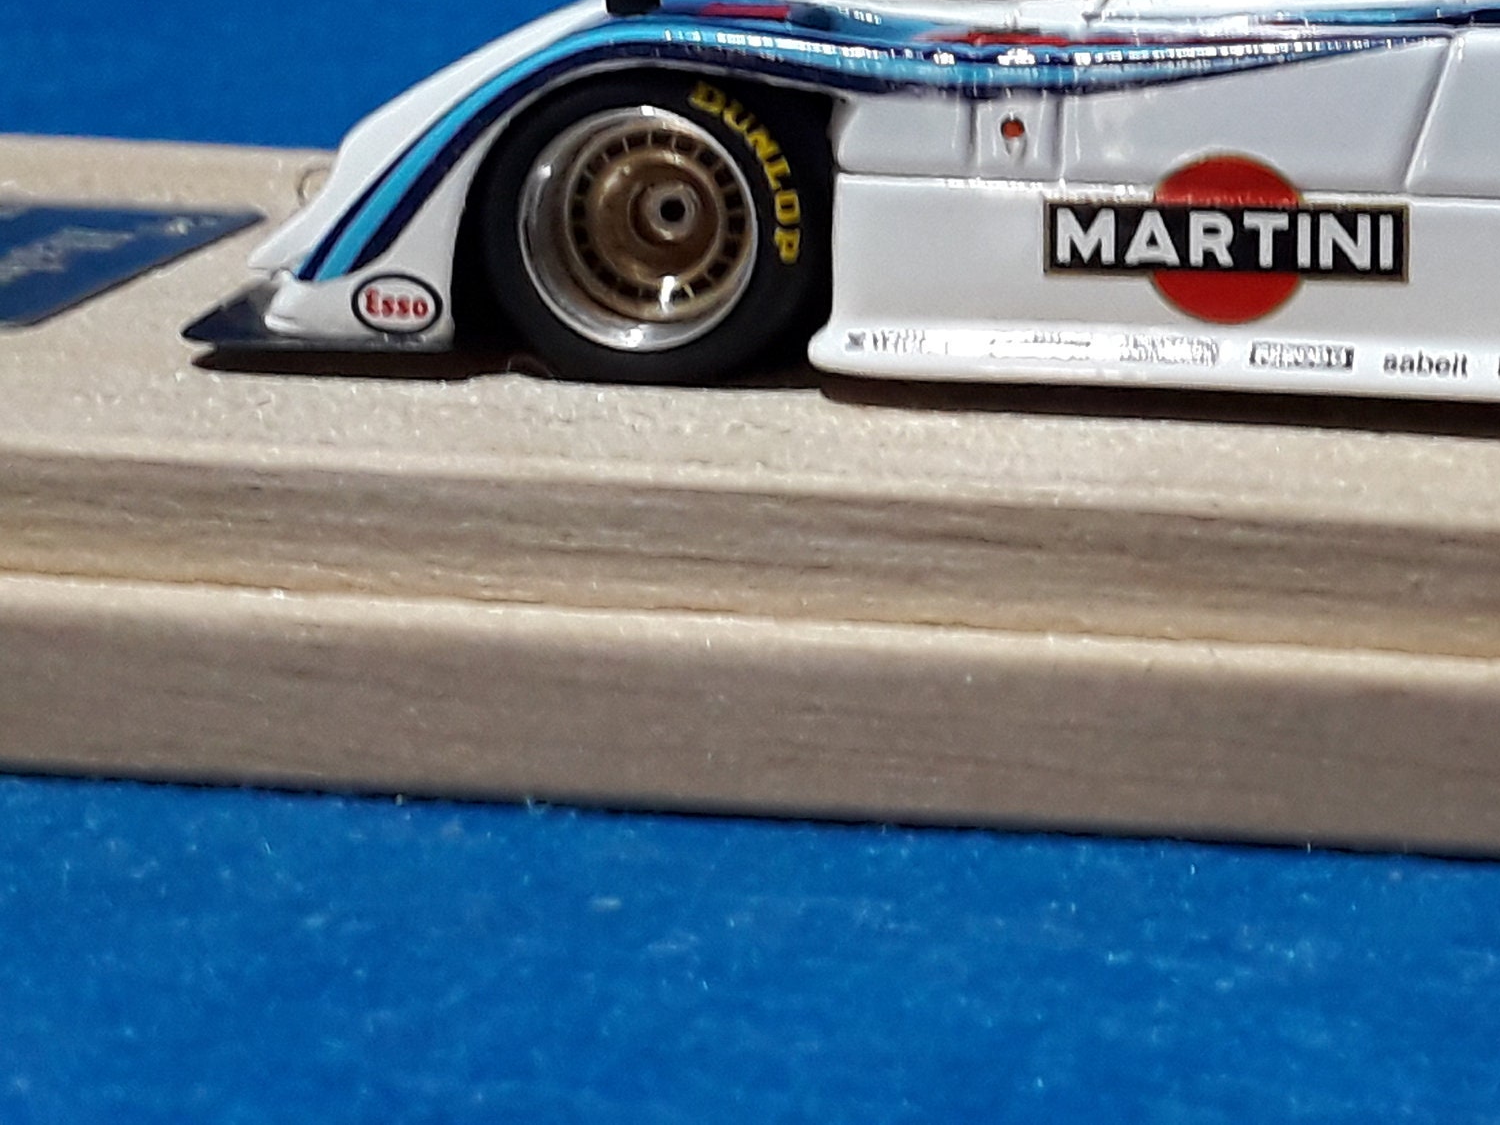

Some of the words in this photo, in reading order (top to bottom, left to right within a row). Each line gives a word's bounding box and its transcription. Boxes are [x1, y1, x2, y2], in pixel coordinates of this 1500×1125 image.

[689, 81, 800, 263] DUNLOP
[1055, 207, 1396, 272] MARTINI
[365, 286, 429, 318] Esso
